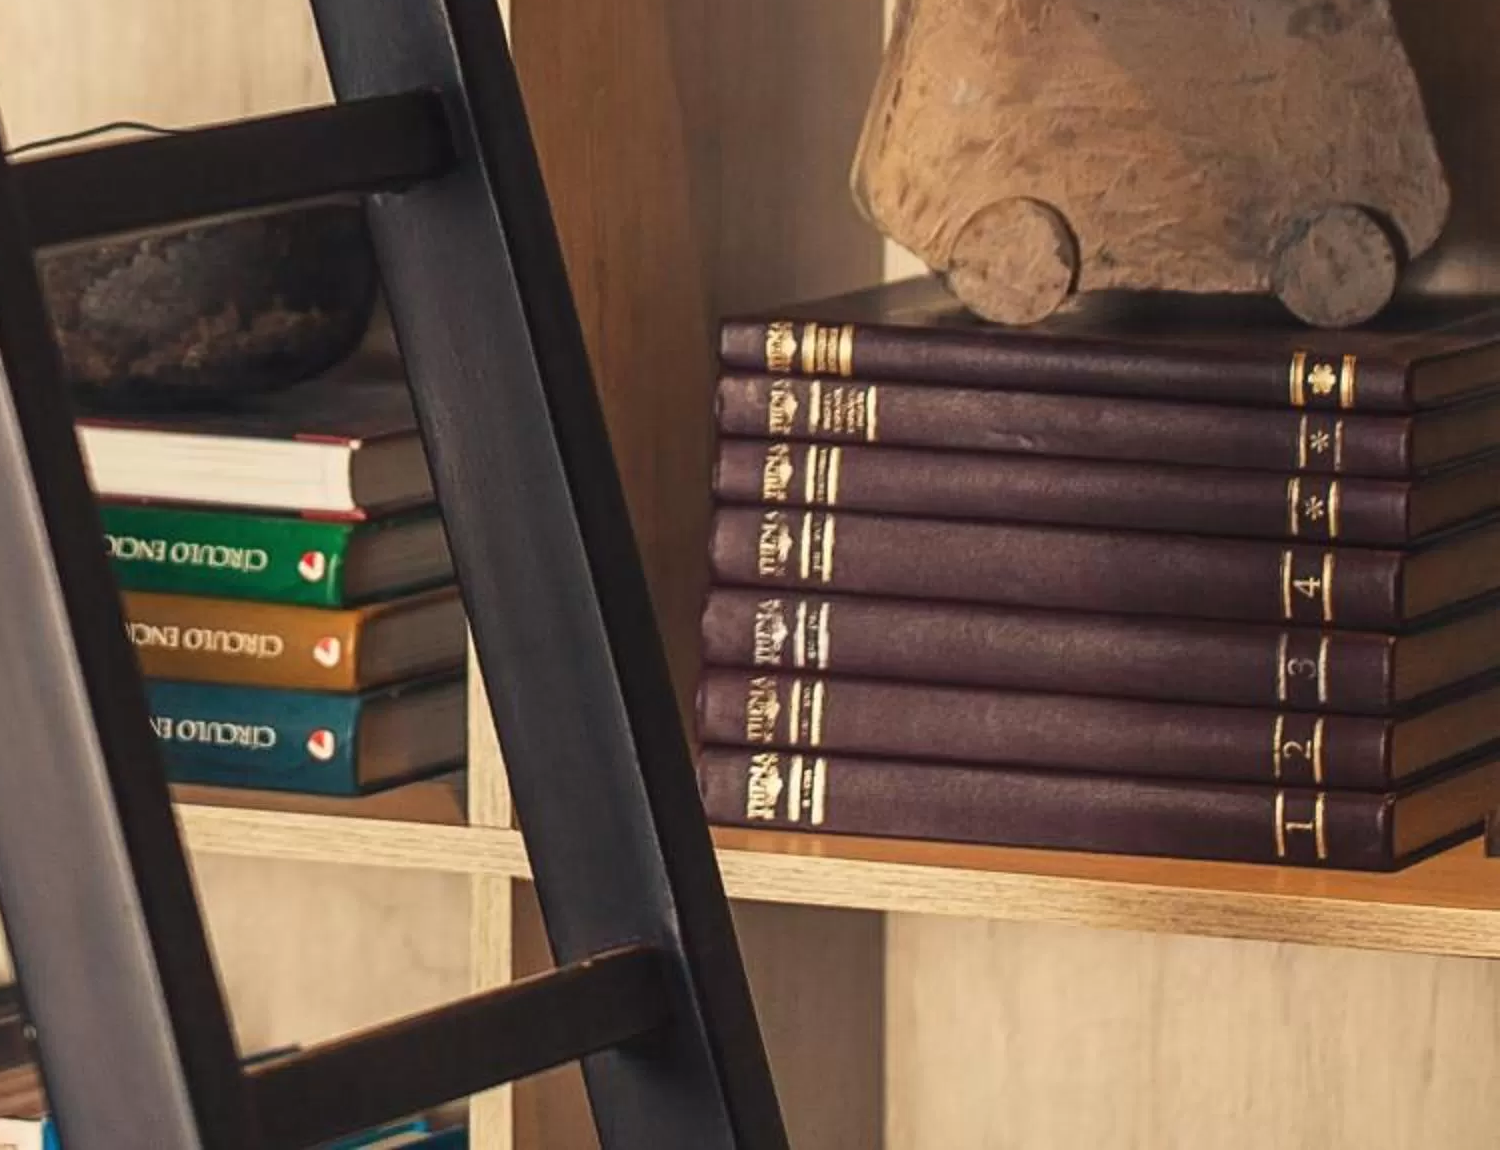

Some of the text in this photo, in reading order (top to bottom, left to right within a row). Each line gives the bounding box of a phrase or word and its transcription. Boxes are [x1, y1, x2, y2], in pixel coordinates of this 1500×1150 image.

[759, 510, 779, 578] THEMA
[1293, 576, 1321, 597] 4
[754, 599, 776, 666] THEMA
[1288, 658, 1317, 679] 3
[747, 677, 768, 742] THEMA
[1284, 741, 1312, 759] 2
[747, 753, 770, 820] THEMA
[1286, 817, 1314, 834] 1
